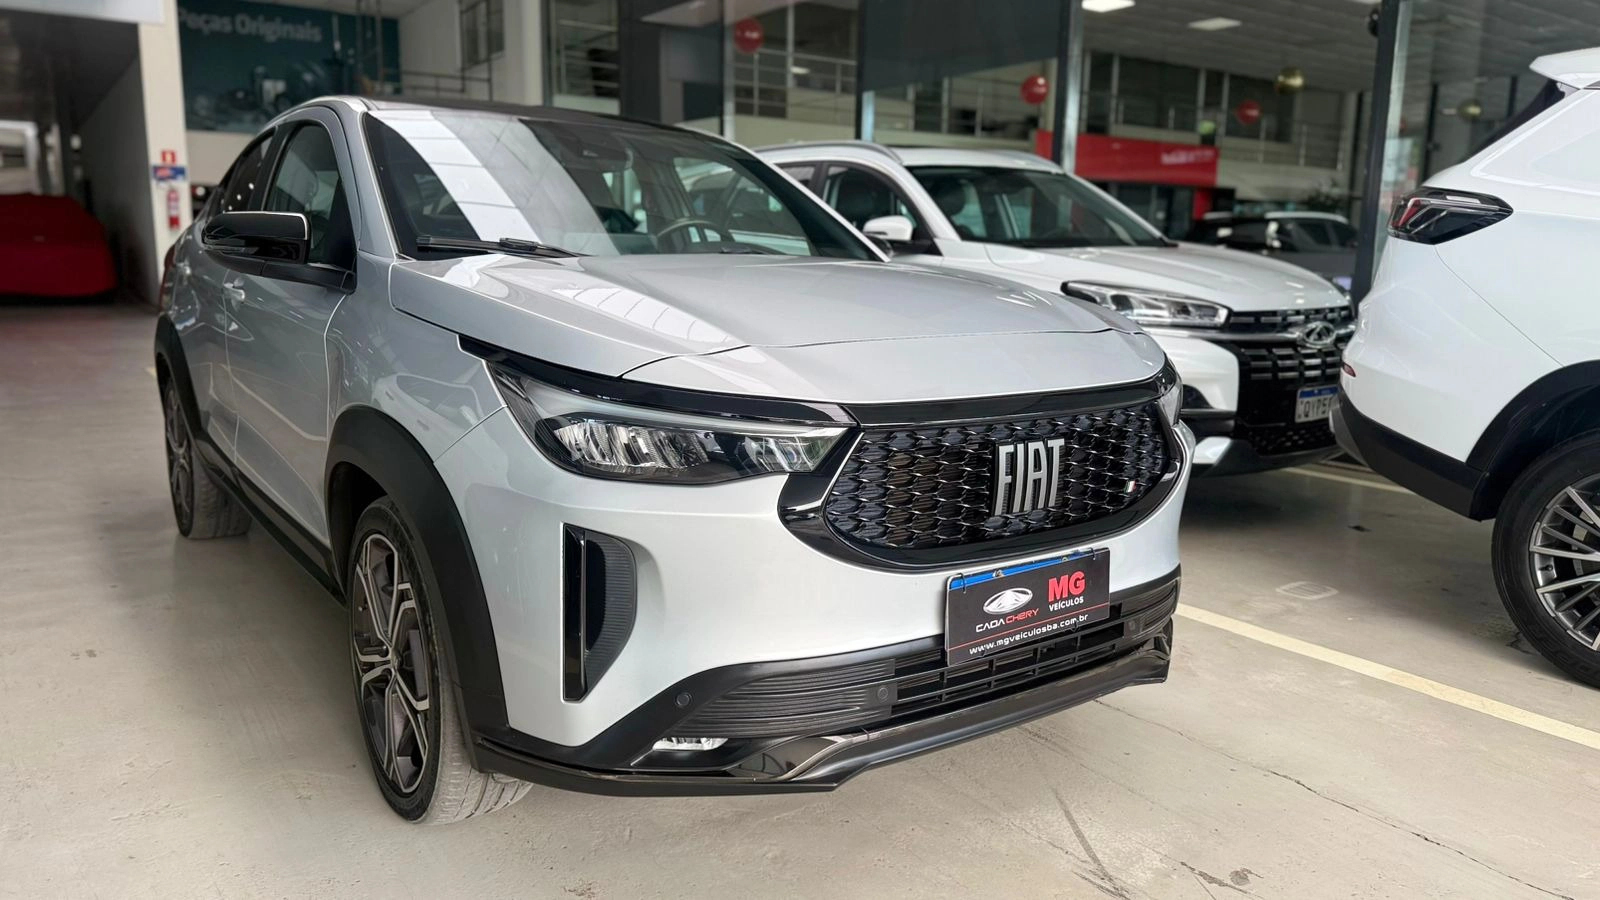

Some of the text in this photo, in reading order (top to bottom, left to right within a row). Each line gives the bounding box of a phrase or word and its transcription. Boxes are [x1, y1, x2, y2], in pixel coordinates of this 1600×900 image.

[178, 7, 323, 43] Peças Originais
[994, 438, 1065, 516] FIAT
[1048, 570, 1086, 602] MG
[969, 613, 1090, 655] www.mgveiculosba.com.br
